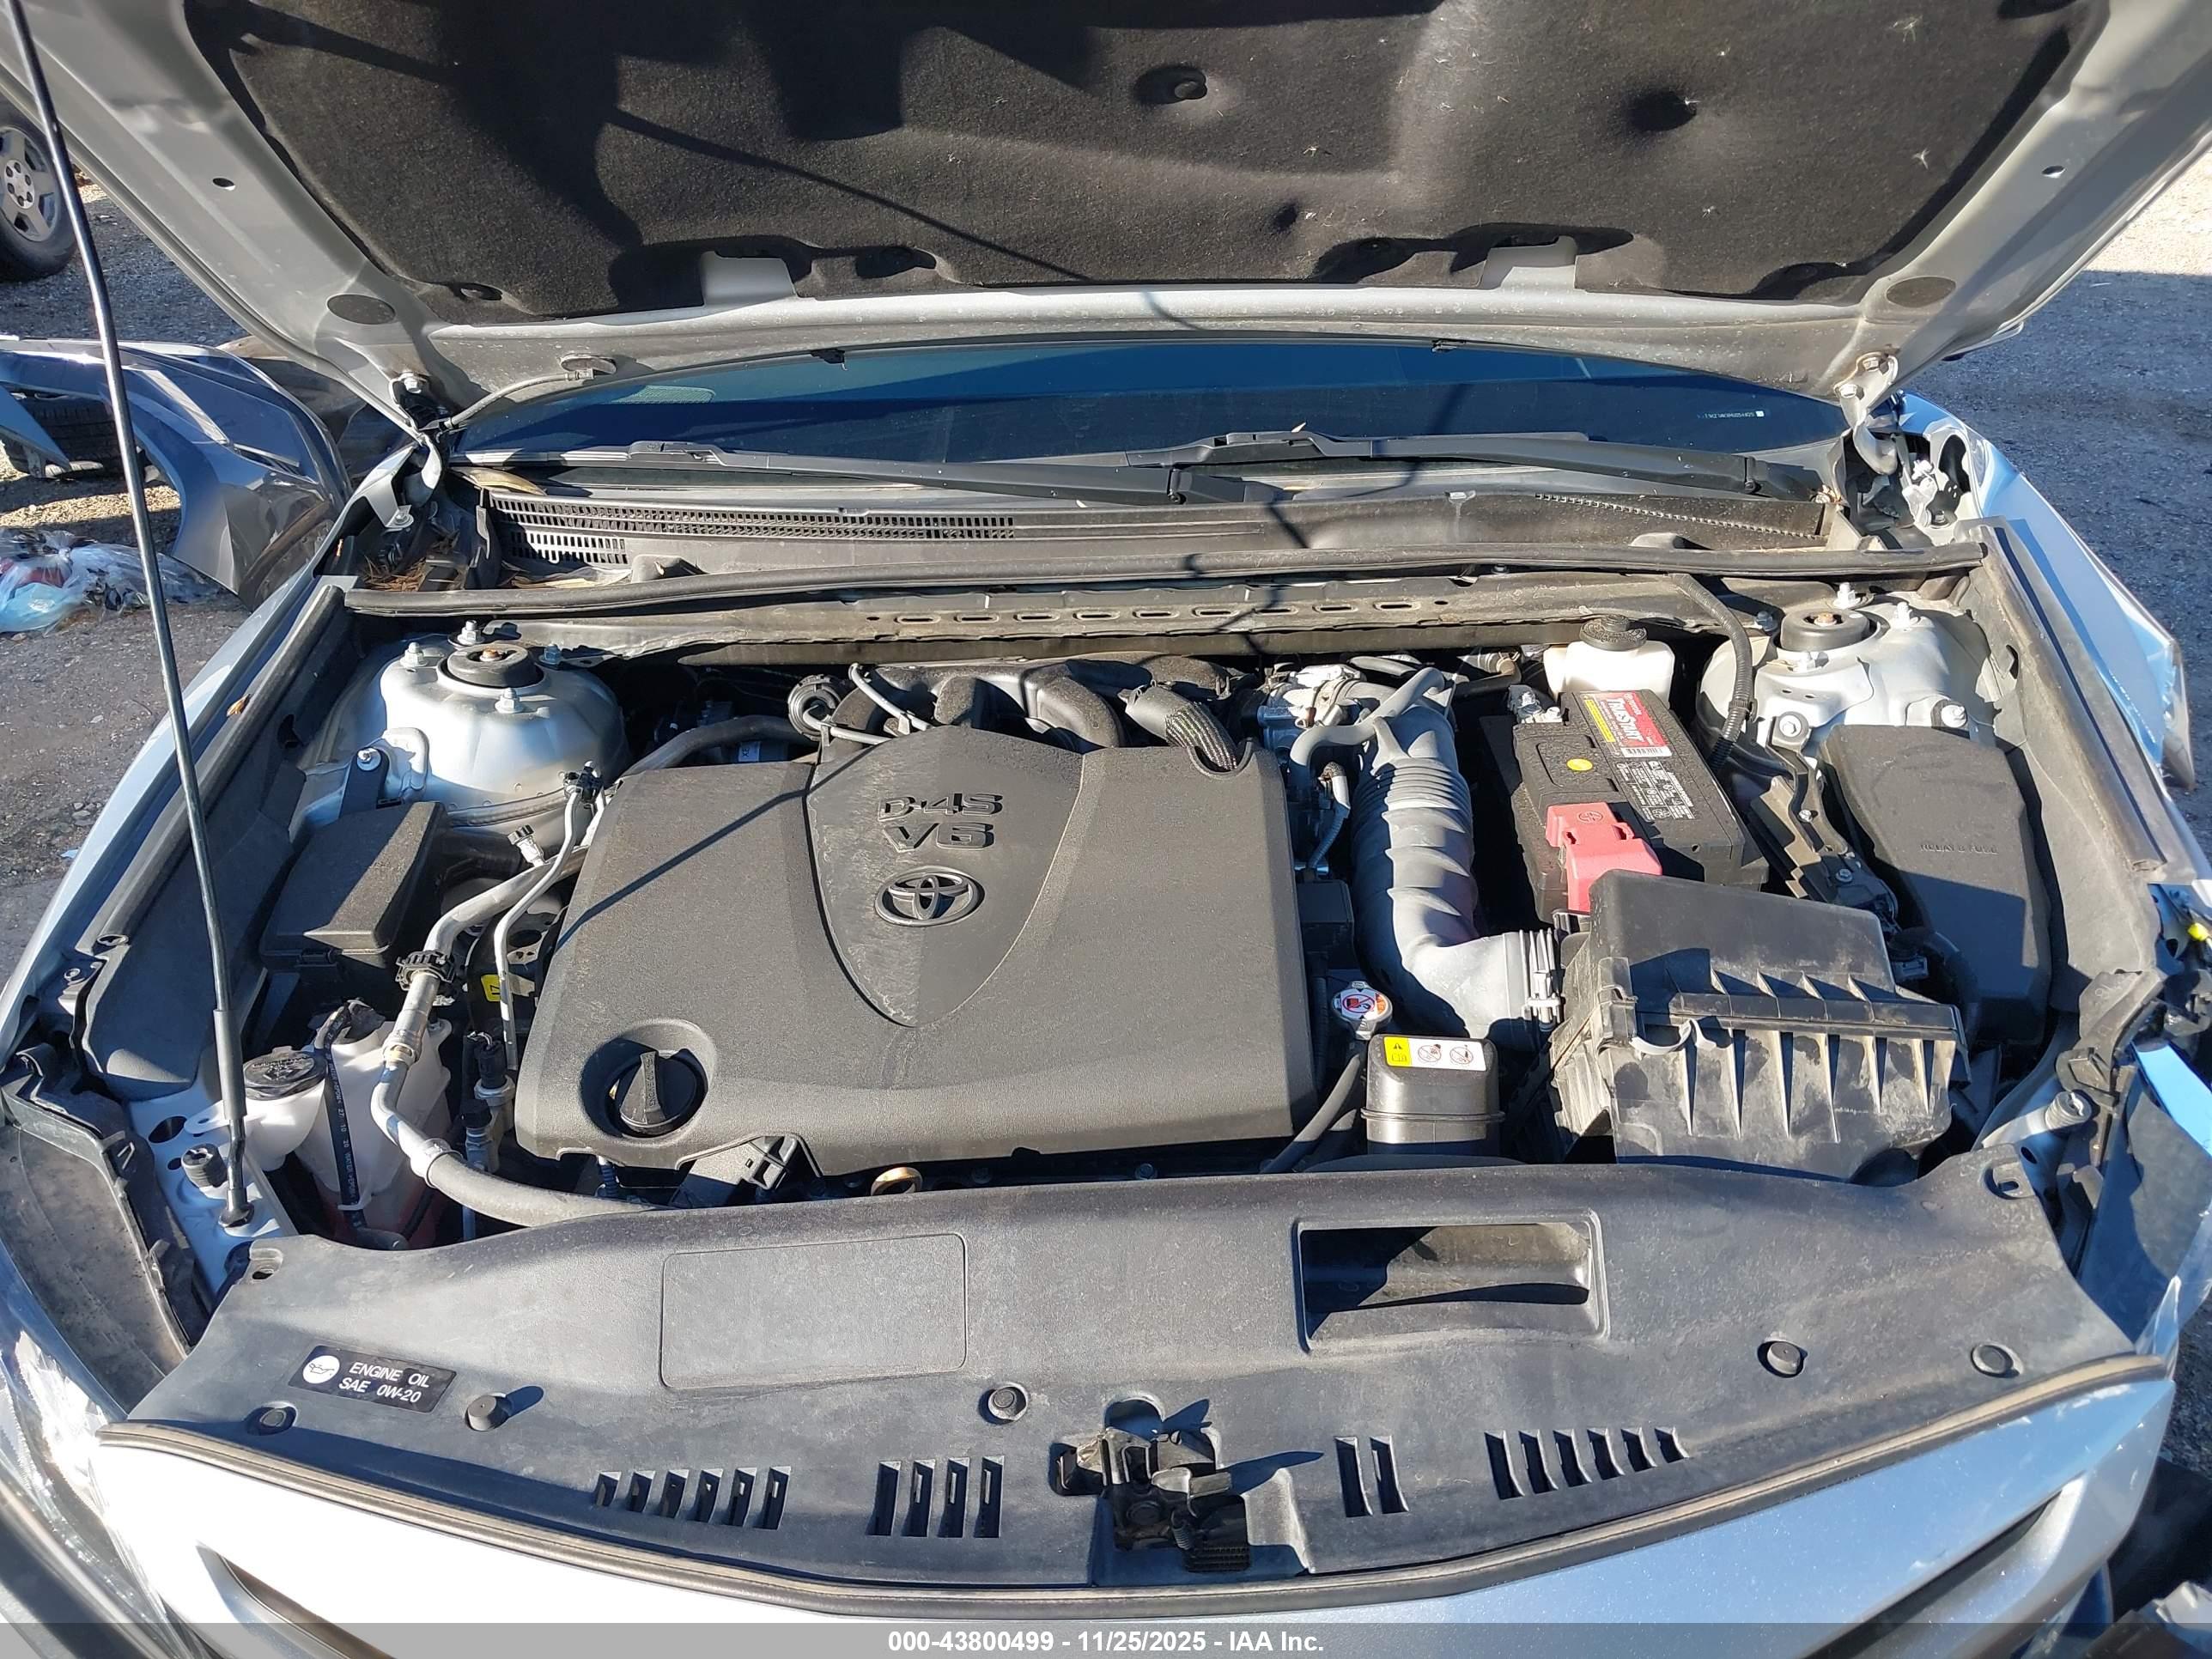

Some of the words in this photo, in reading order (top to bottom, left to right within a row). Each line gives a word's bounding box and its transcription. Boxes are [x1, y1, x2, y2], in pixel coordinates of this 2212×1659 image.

[882, 823, 995, 853] V6
[349, 1361, 404, 1382] ENGINE
[408, 1372, 430, 1389] OIL
[338, 1377, 371, 1394] SAE
[376, 1384, 422, 1403] 0W-20
